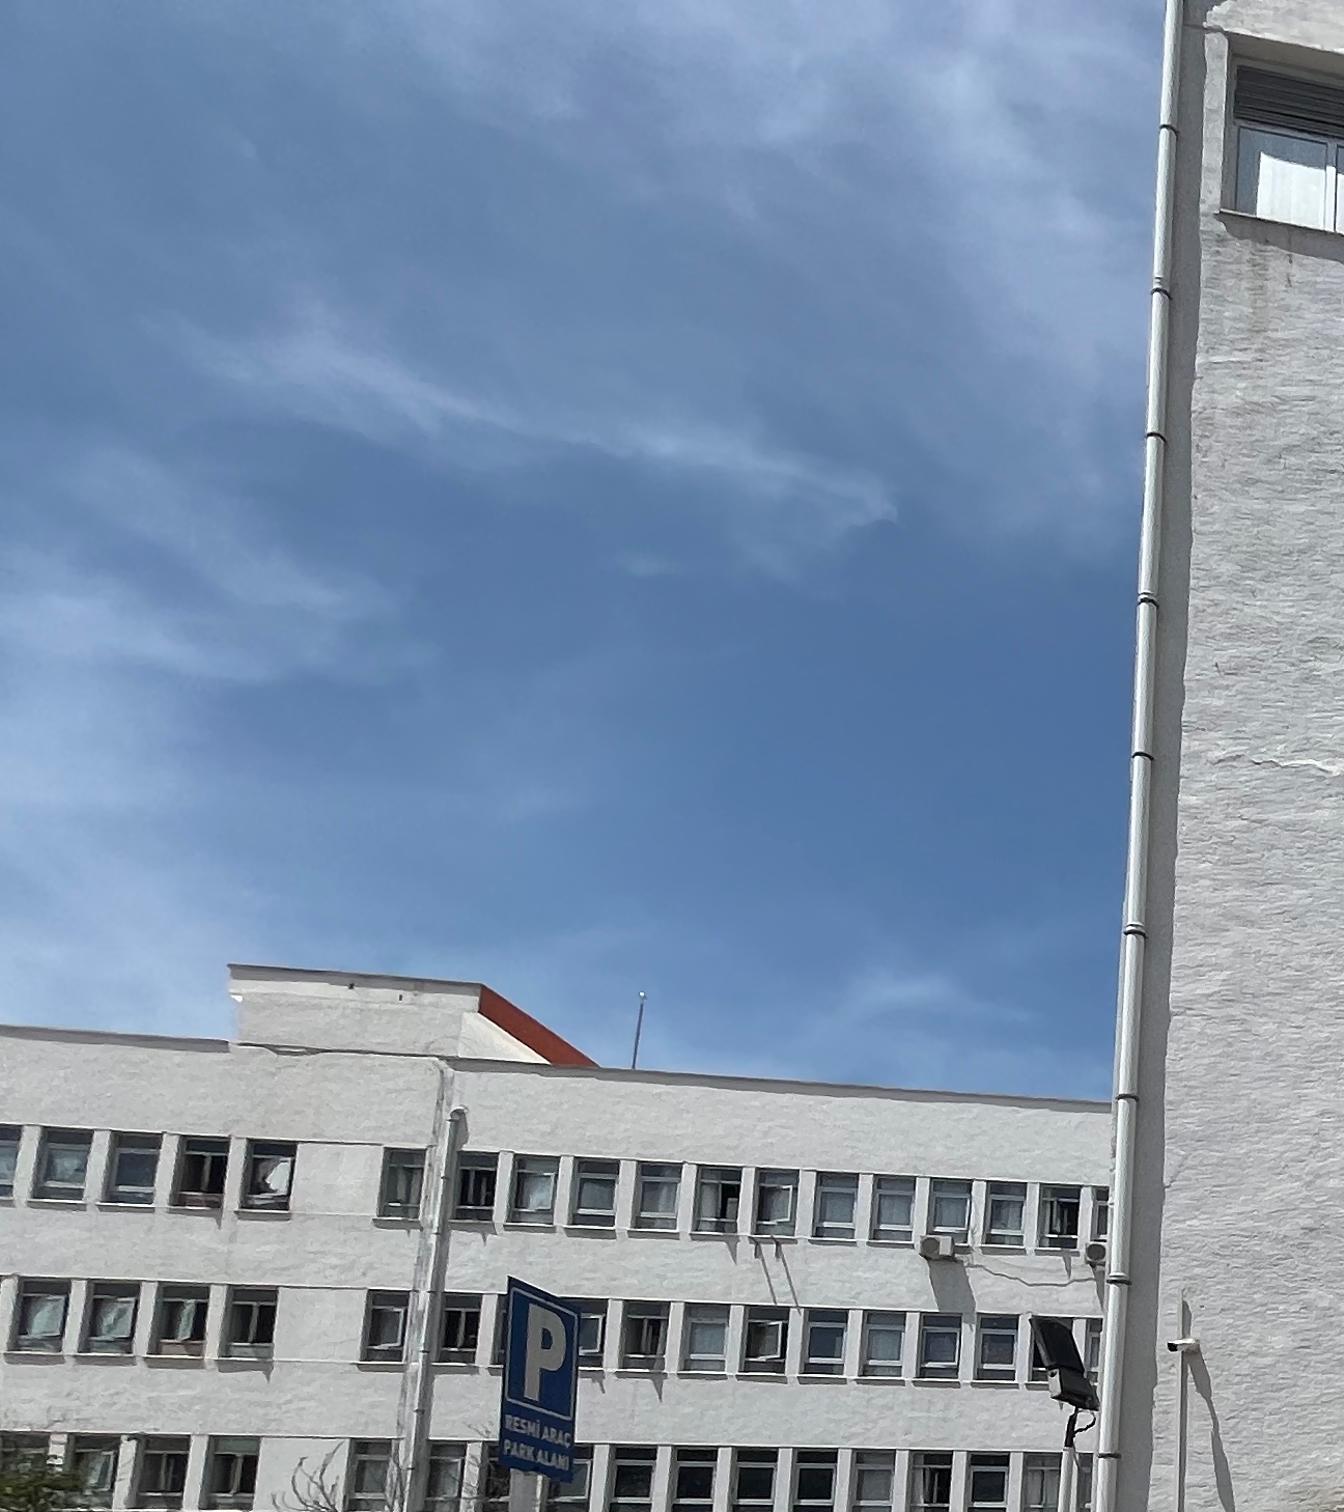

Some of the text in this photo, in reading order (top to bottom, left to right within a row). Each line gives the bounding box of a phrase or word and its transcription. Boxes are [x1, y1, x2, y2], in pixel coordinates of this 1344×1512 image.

[523, 1303, 567, 1402] P
[505, 1414, 571, 1449] RESMİ ARAÇ
[503, 1439, 570, 1471] PARK ALANI
